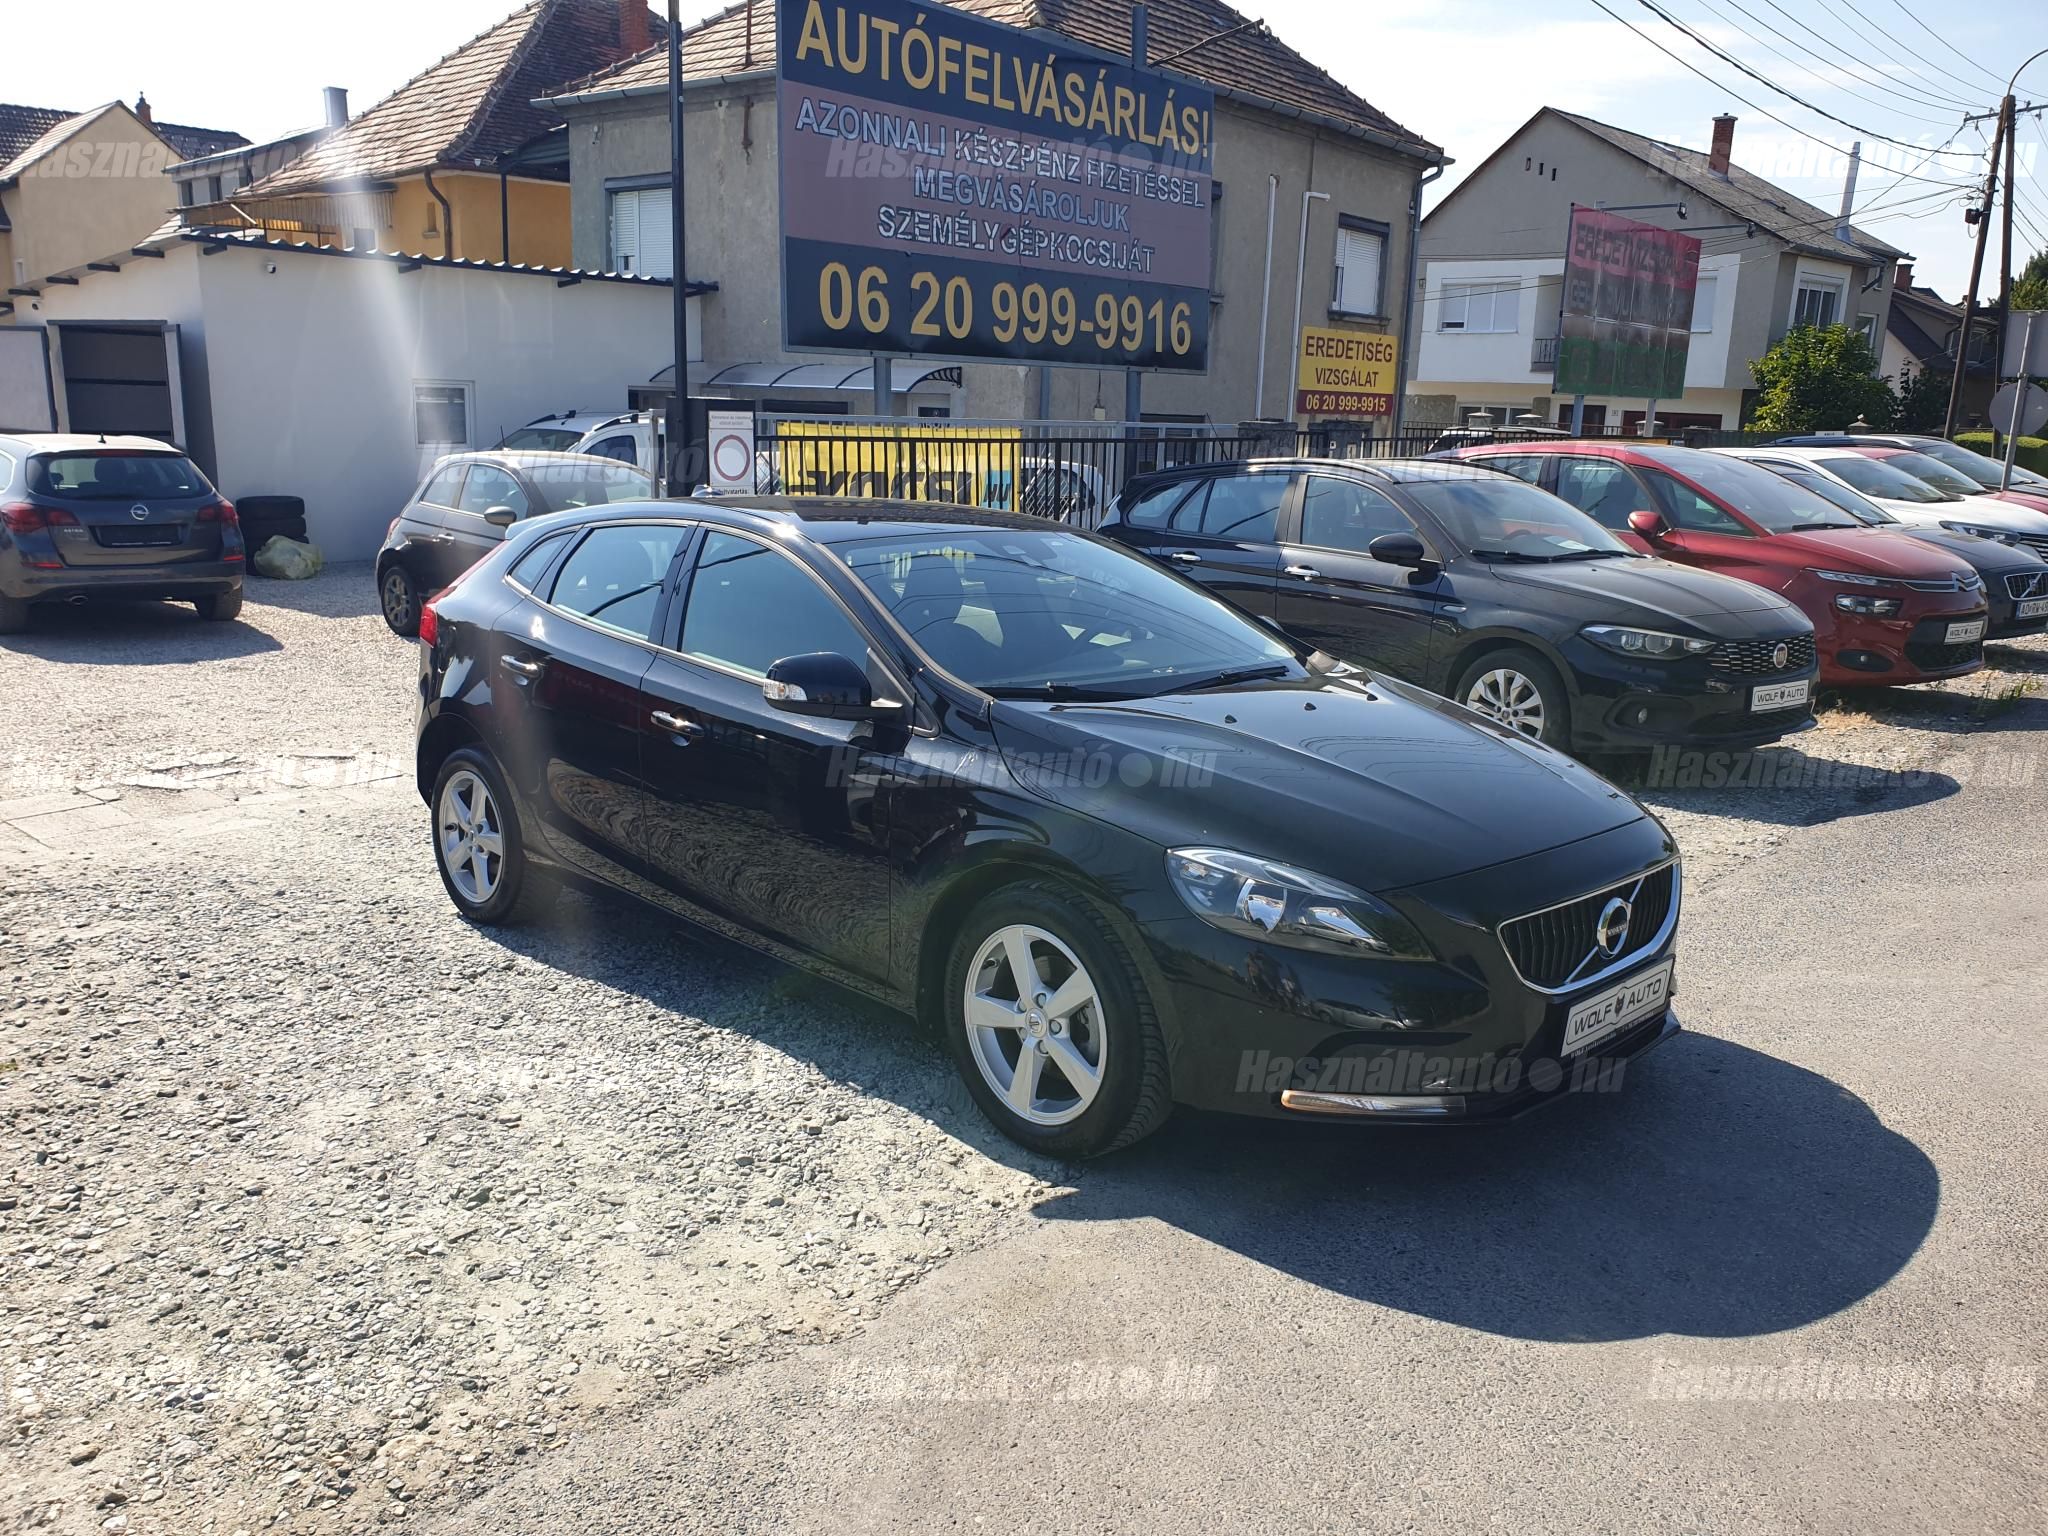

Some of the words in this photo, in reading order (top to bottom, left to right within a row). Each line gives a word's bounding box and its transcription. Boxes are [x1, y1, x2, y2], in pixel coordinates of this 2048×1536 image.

[795, 0, 1209, 158] AUTÓFELVÁSÁRLÁS!
[795, 97, 947, 157] AZONNALI
[954, 127, 1080, 184] KÉSZPÉNZ
[1086, 158, 1205, 208] FIZETÉSSEL
[914, 167, 1130, 233] MEGVÁSÁROLJUK
[818, 261, 890, 334] 06
[910, 272, 973, 340] 20
[992, 281, 1192, 356] 999-9916
[1305, 335, 1393, 363] EREDETISÉG
[1315, 366, 1379, 387] VIZSGÁLAT
[1306, 394, 1320, 410] 06
[1322, 395, 1335, 411] 20
[1338, 396, 1387, 412] 999-9915
[1757, 692, 1779, 703] WOLF
[1787, 688, 1805, 698] AUTO
[1574, 1003, 1613, 1036] WOLF
[1626, 978, 1661, 1009] AUTO
